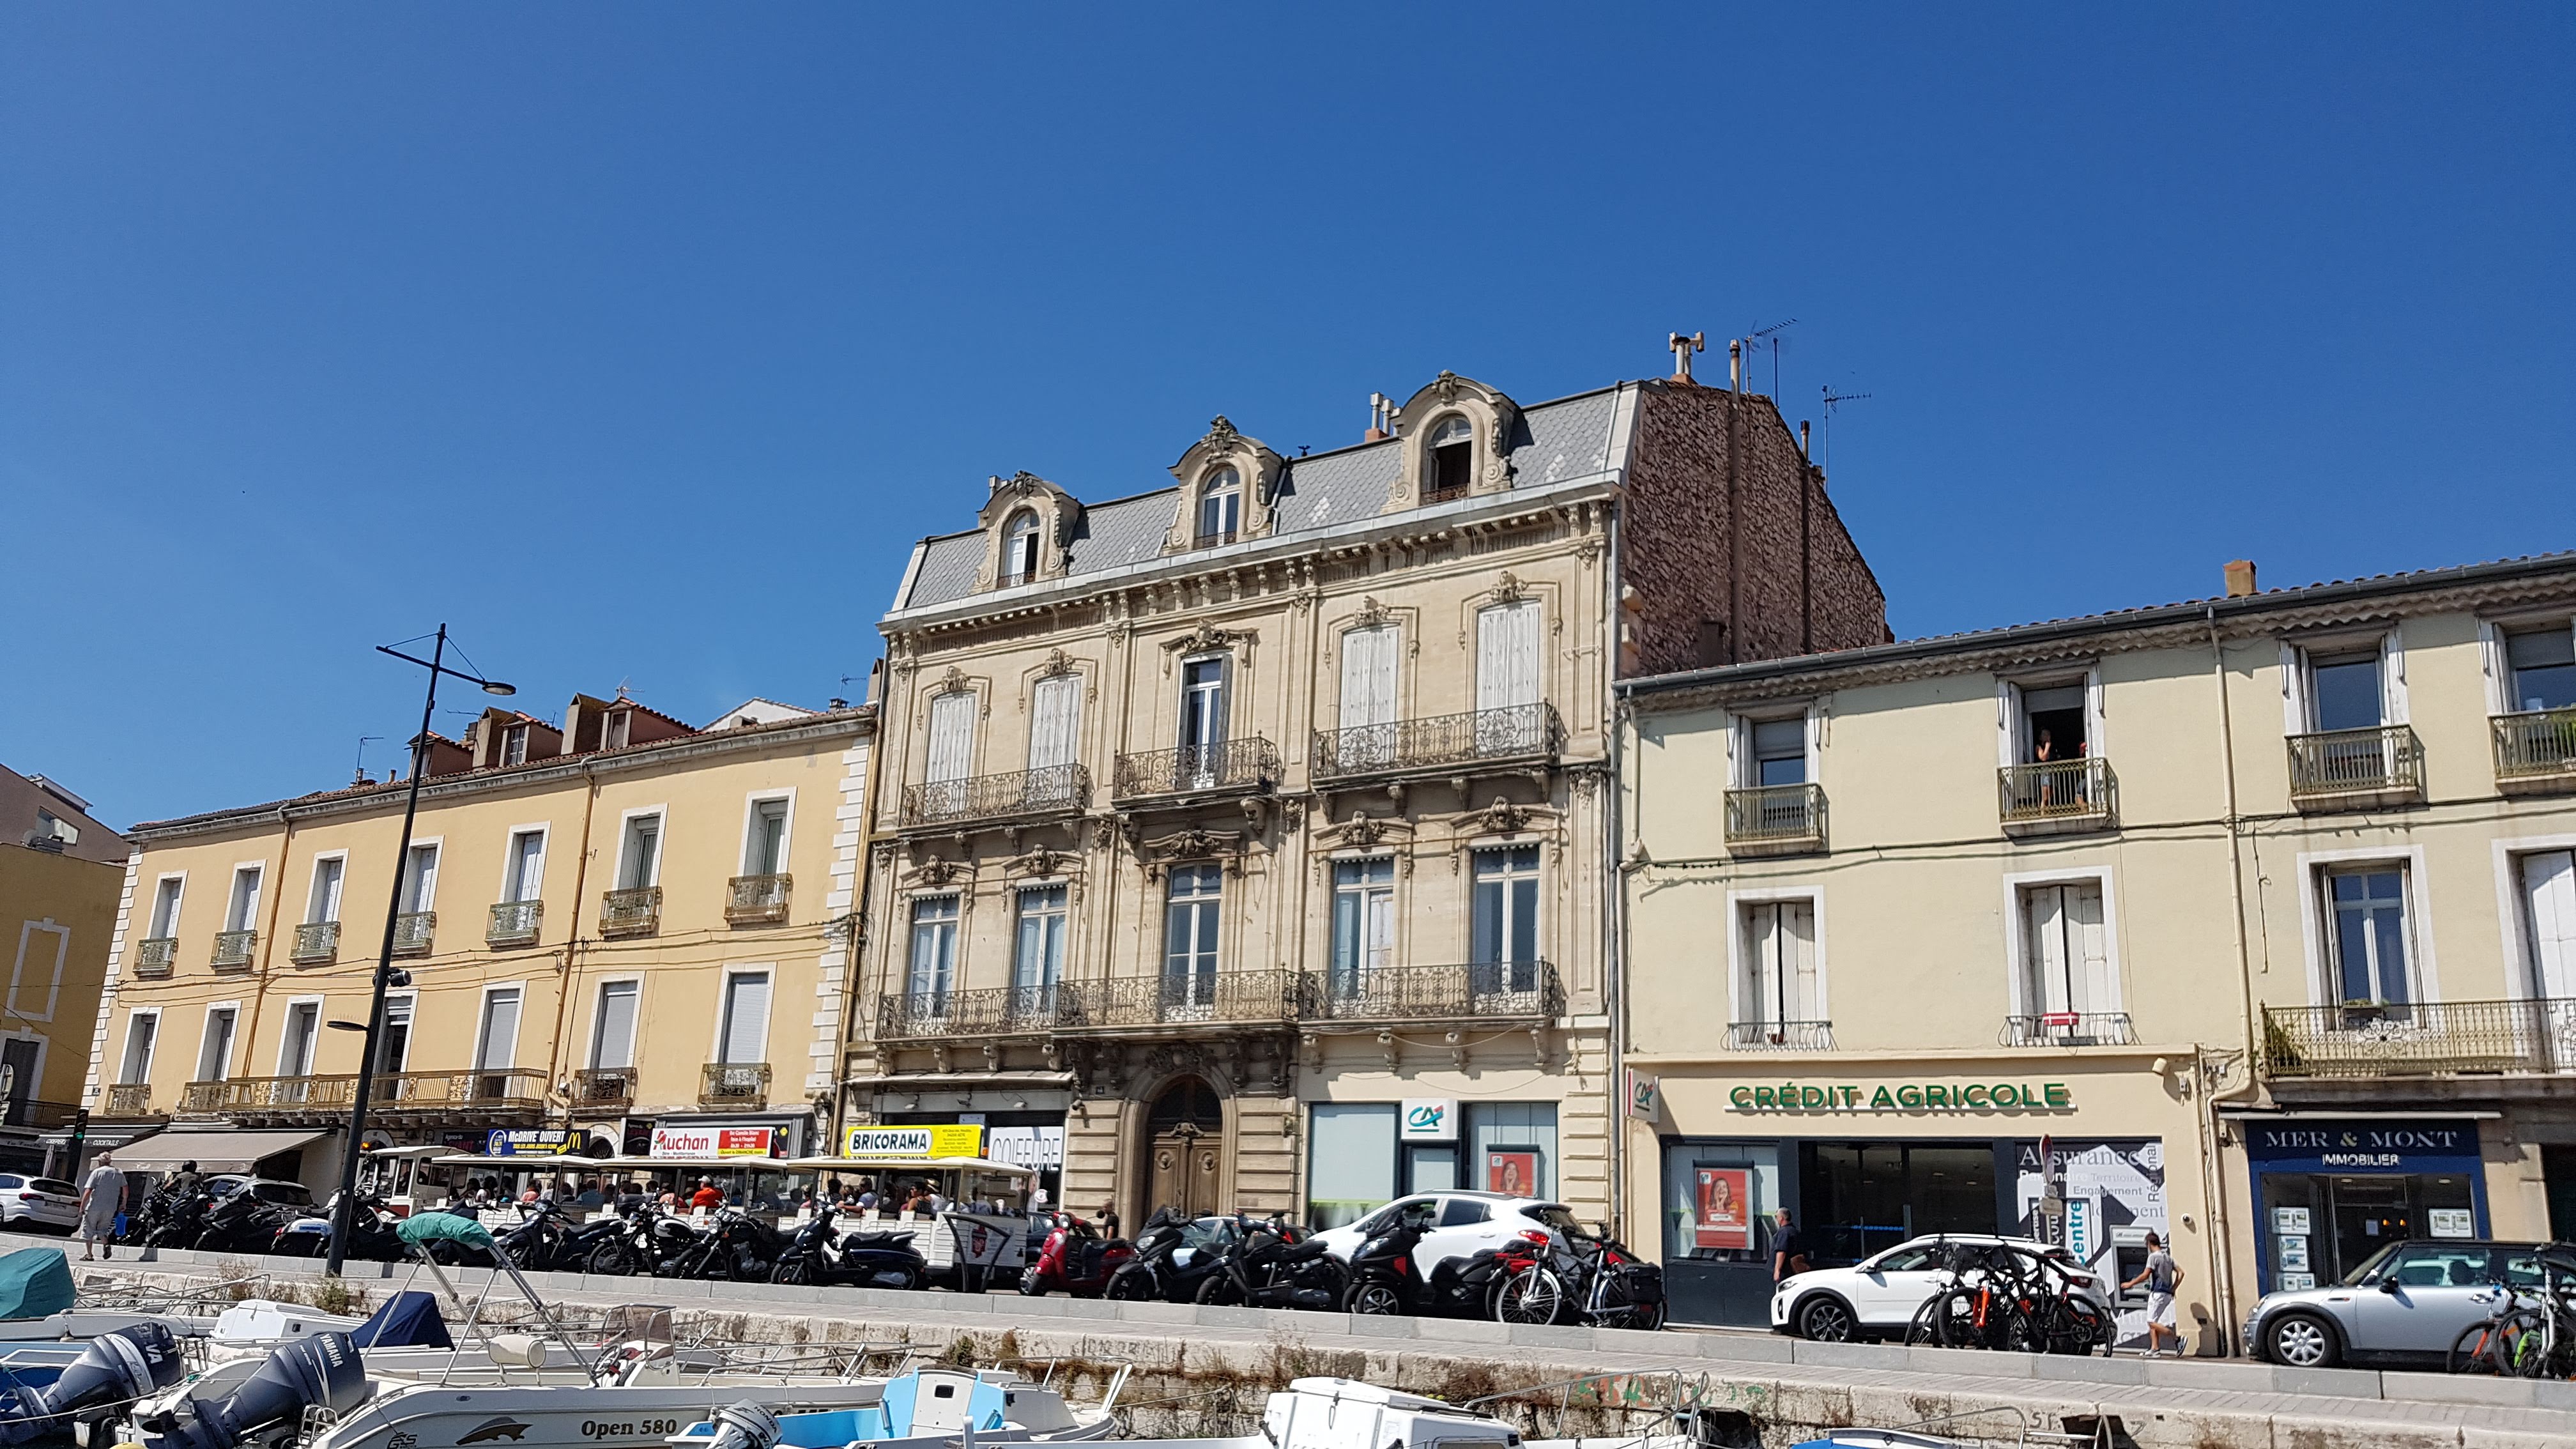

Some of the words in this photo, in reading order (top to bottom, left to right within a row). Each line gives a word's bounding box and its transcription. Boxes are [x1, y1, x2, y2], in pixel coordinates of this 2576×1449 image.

[1729, 1082, 1858, 1108] CRÉDIT
[1870, 1082, 2066, 1107] AGRICOLE
[539, 1130, 566, 1143] OUVERT
[654, 1130, 709, 1150] Auchan
[852, 1133, 927, 1150] BRICORAMA
[2265, 1131, 2330, 1147] MER
[2340, 1131, 2358, 1147] &
[2369, 1130, 2458, 1148] MONT
[992, 1137, 1061, 1171] COIFFURE
[2019, 1146, 2140, 1167] Asurance
[2322, 1153, 2401, 1167] IMMOBILIER
[319, 1333, 344, 1368] YAMAHA
[581, 1420, 634, 1441] Open
[640, 1419, 677, 1435] 580
[753, 1406, 778, 1434] HONDA
